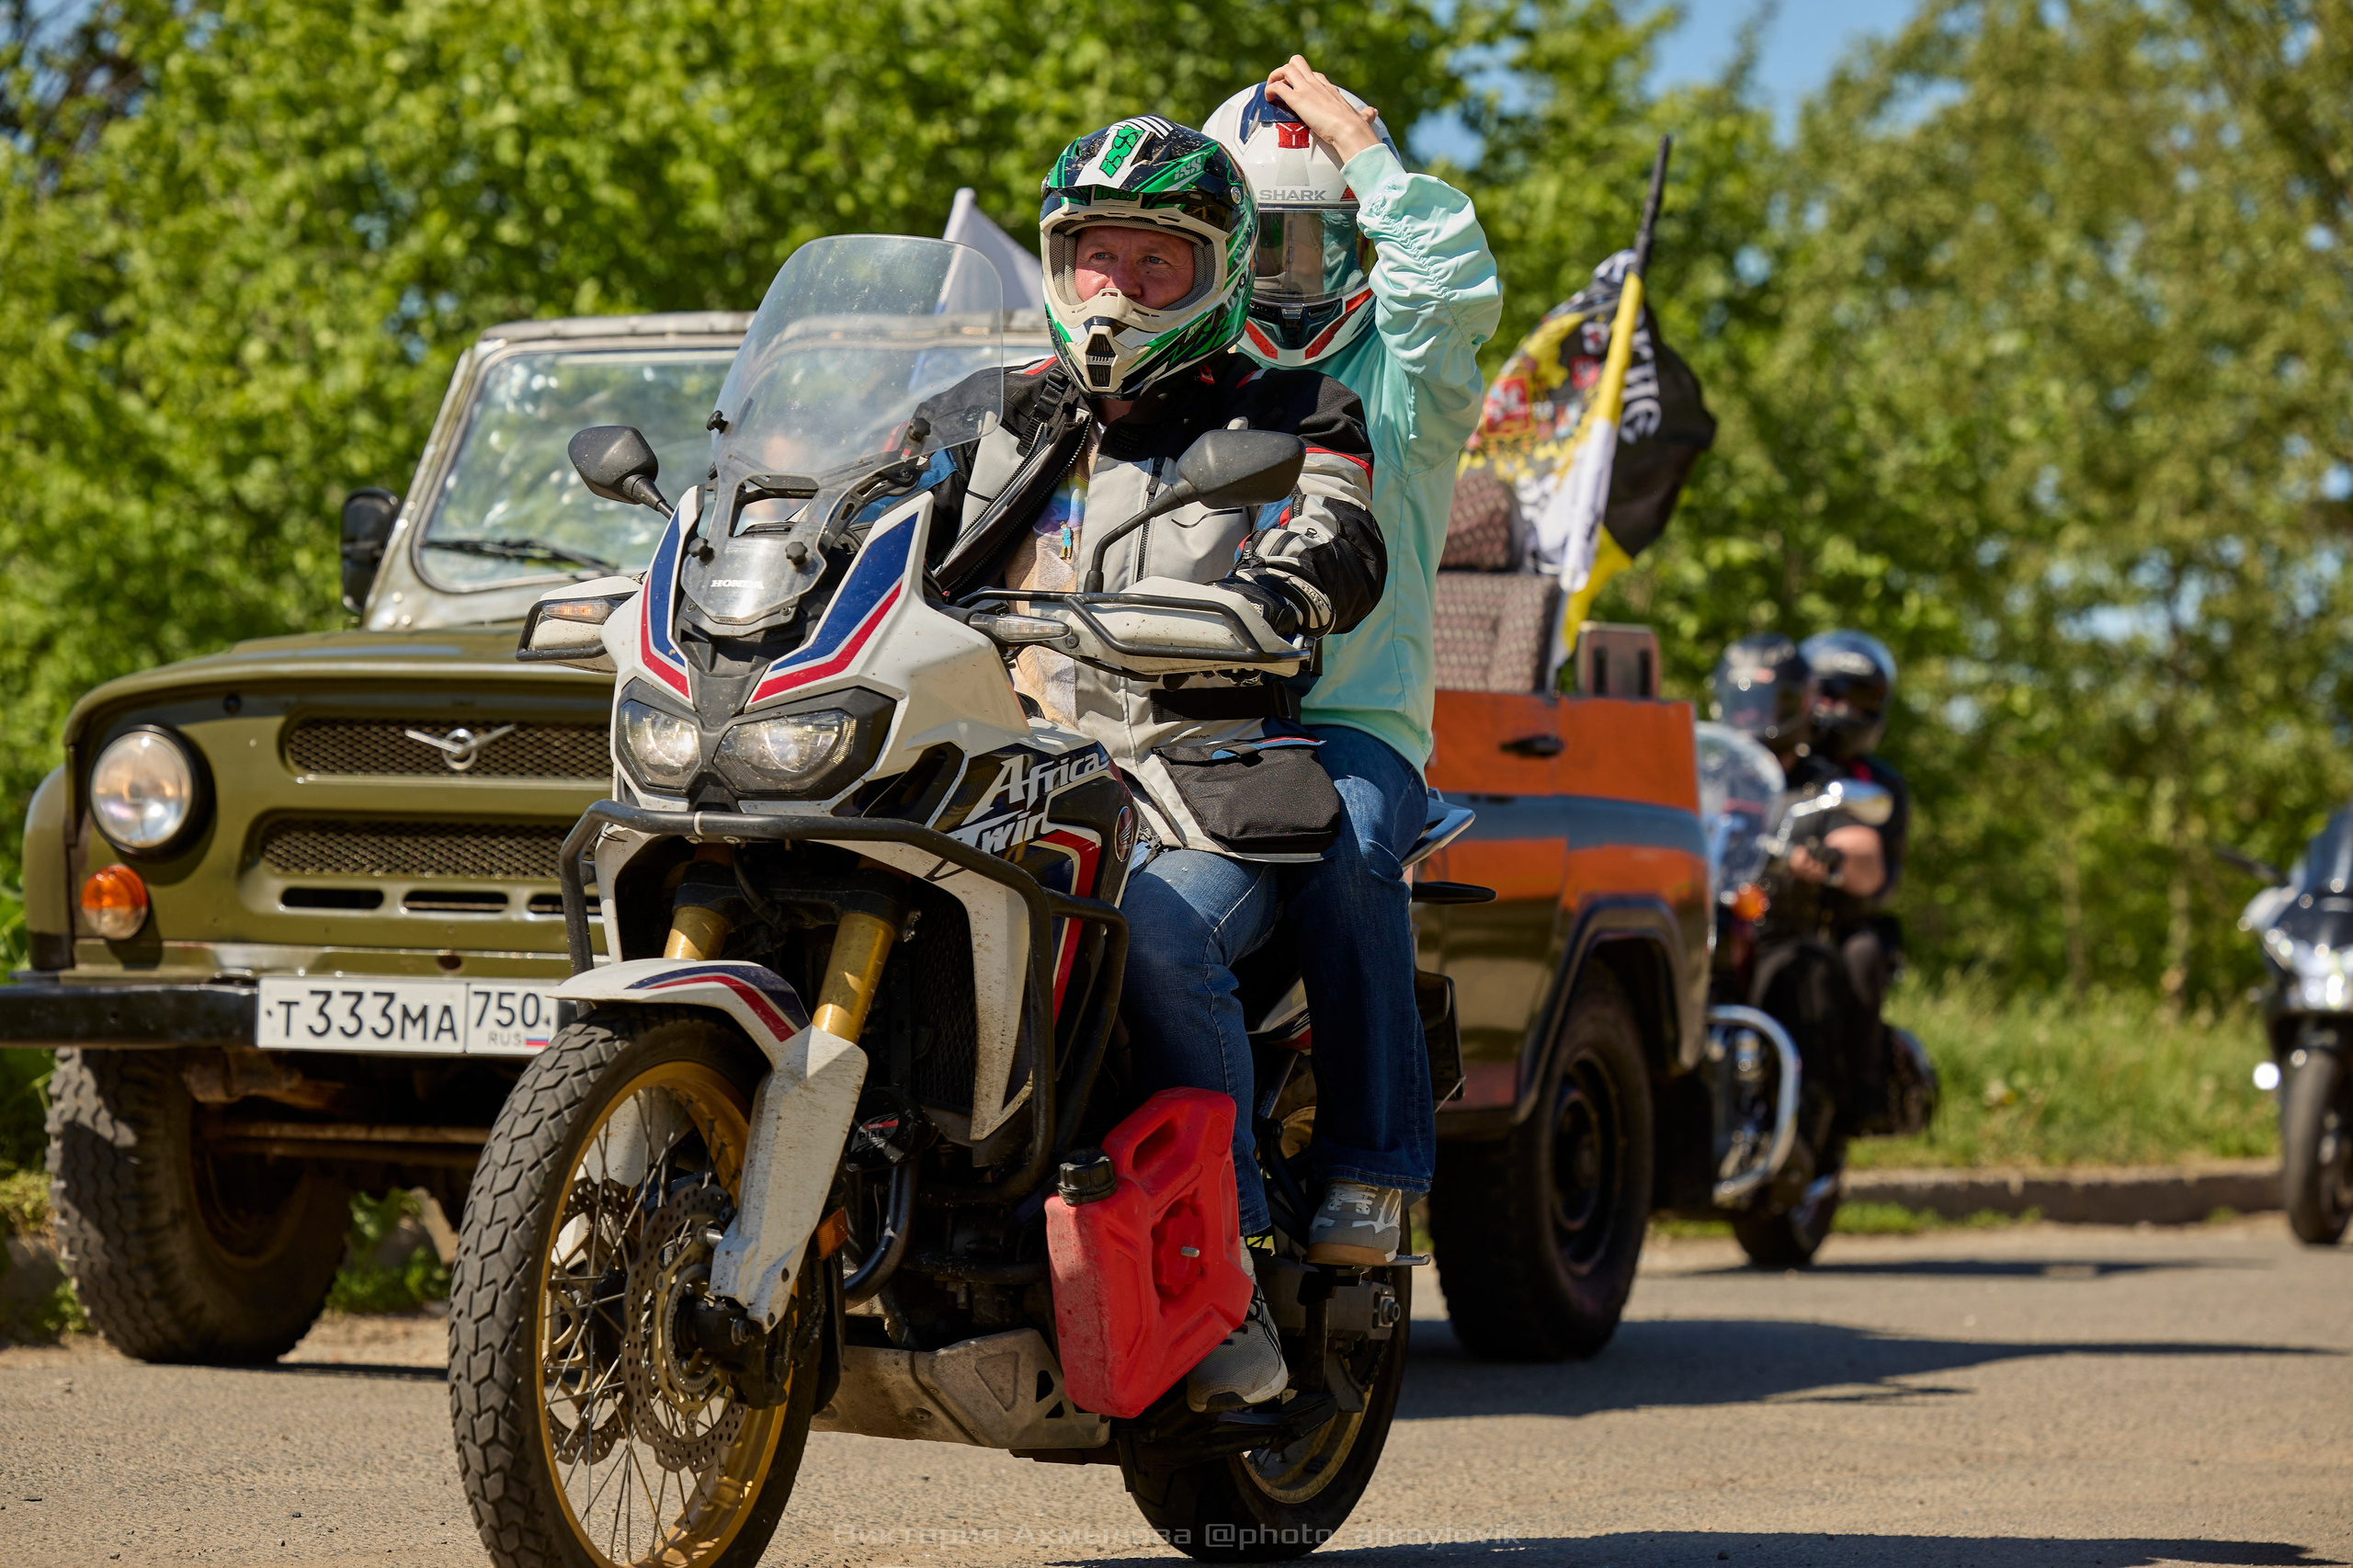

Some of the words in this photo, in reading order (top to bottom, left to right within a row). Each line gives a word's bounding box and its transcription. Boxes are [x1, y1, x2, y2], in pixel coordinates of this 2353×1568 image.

[1258, 189, 1326, 200] SHARK
[961, 753, 1108, 825] Africa
[278, 990, 458, 1041] Т333МА
[472, 991, 540, 1028] 750
[488, 1034, 522, 1047] RUS
